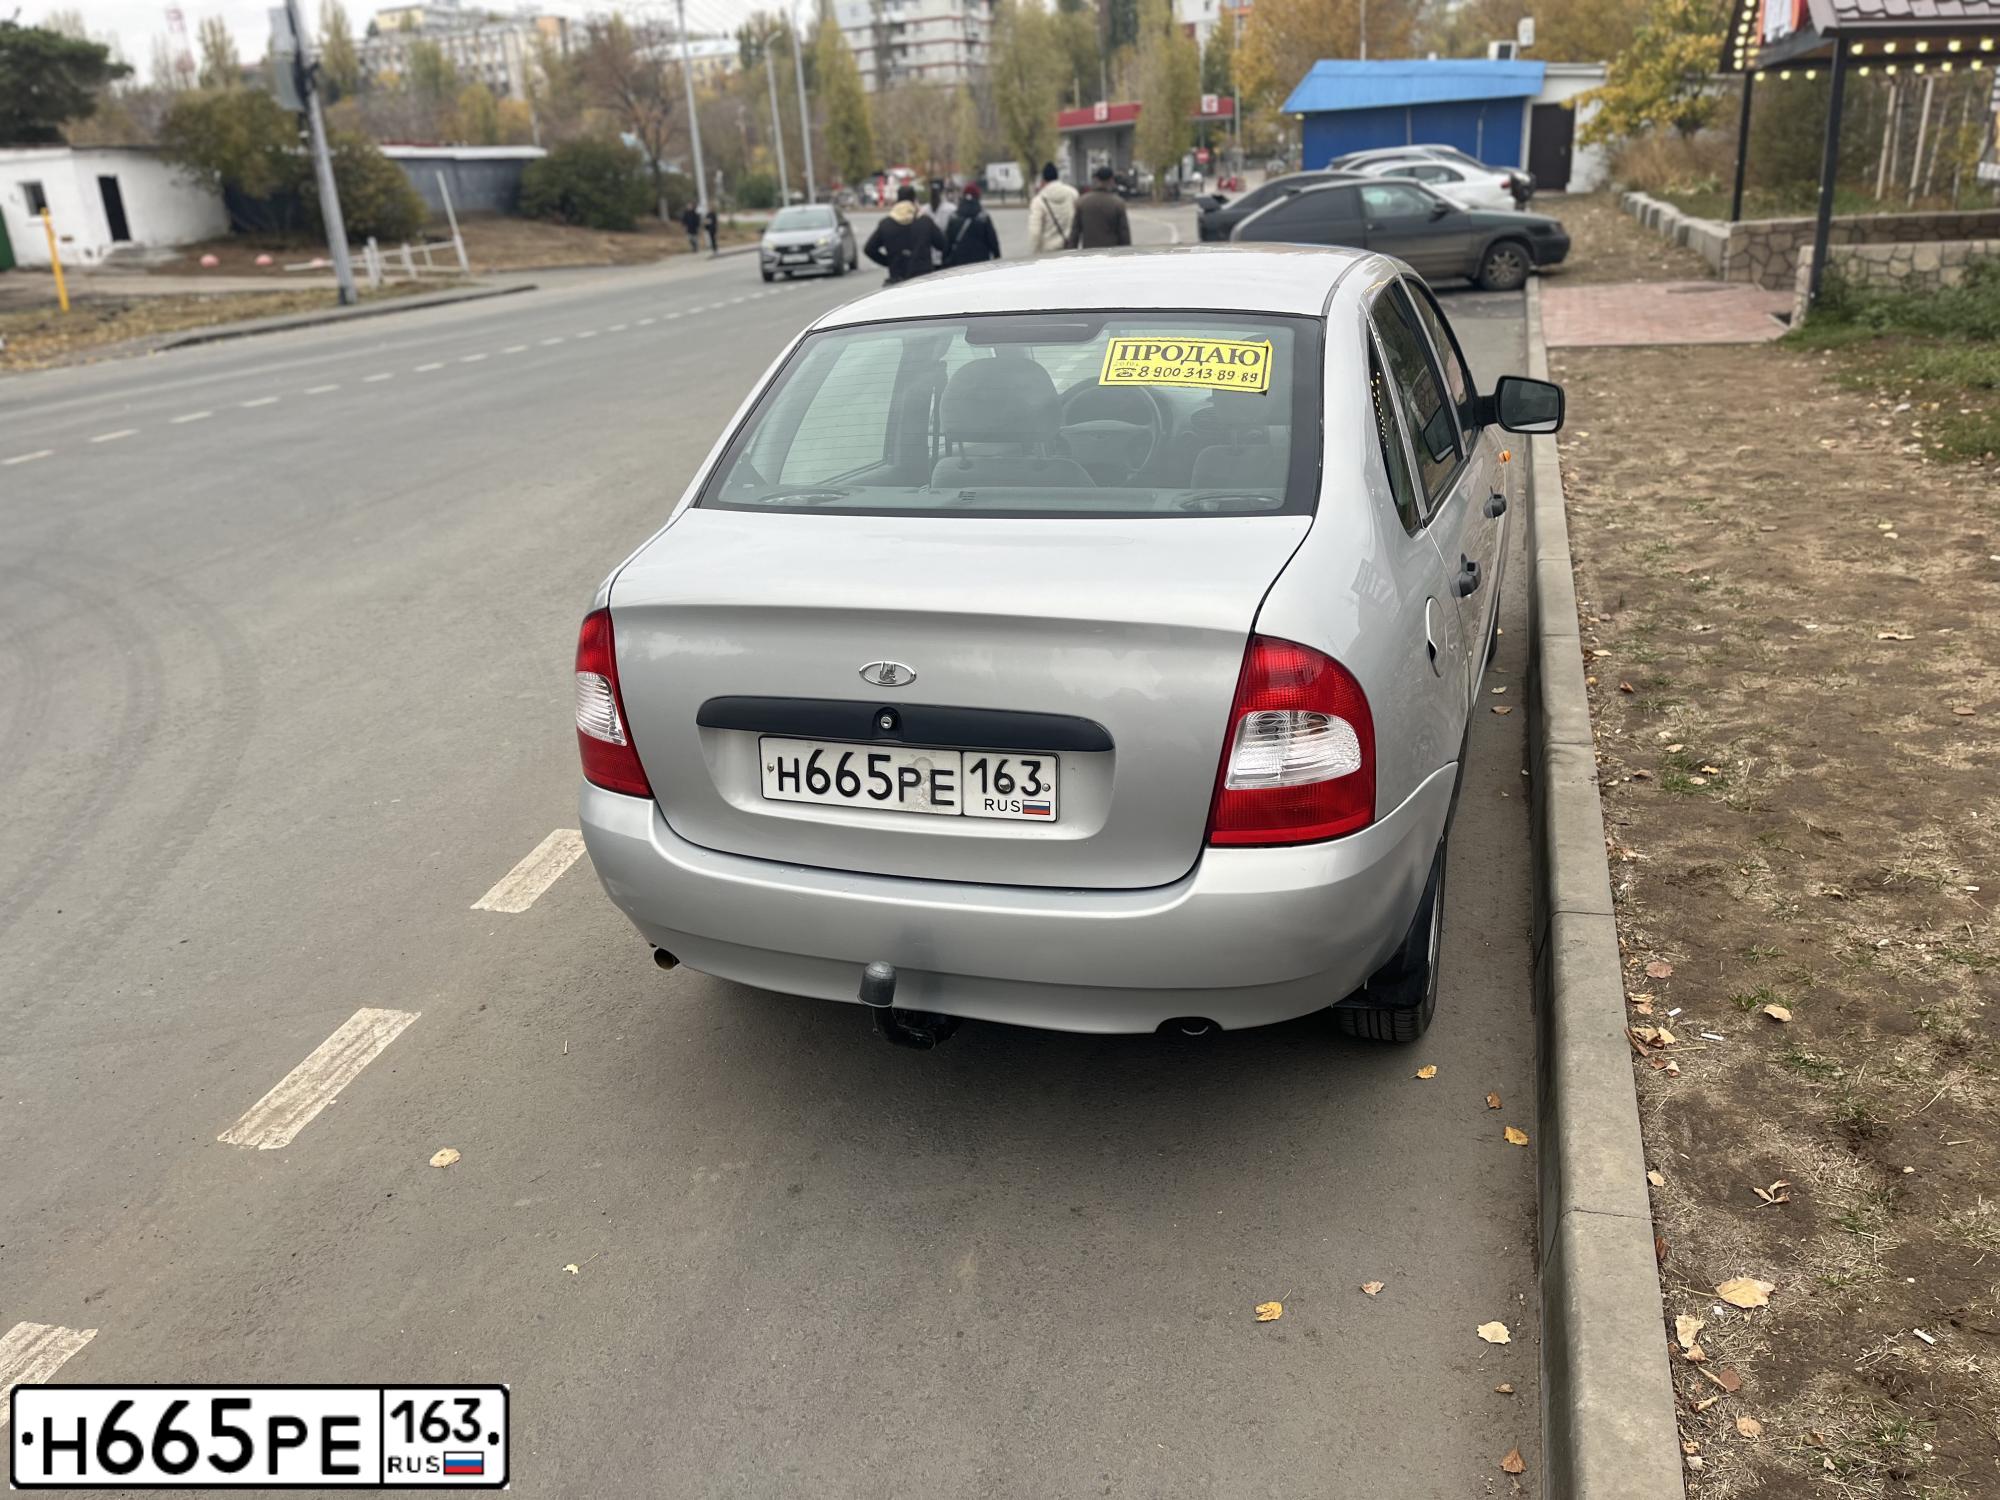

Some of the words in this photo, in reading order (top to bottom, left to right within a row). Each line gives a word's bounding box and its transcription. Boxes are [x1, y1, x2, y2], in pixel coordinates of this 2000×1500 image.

[1117, 344, 1260, 366] ПРОДАЮ
[970, 758, 1042, 797] 163
[984, 798, 1021, 813] RUS
